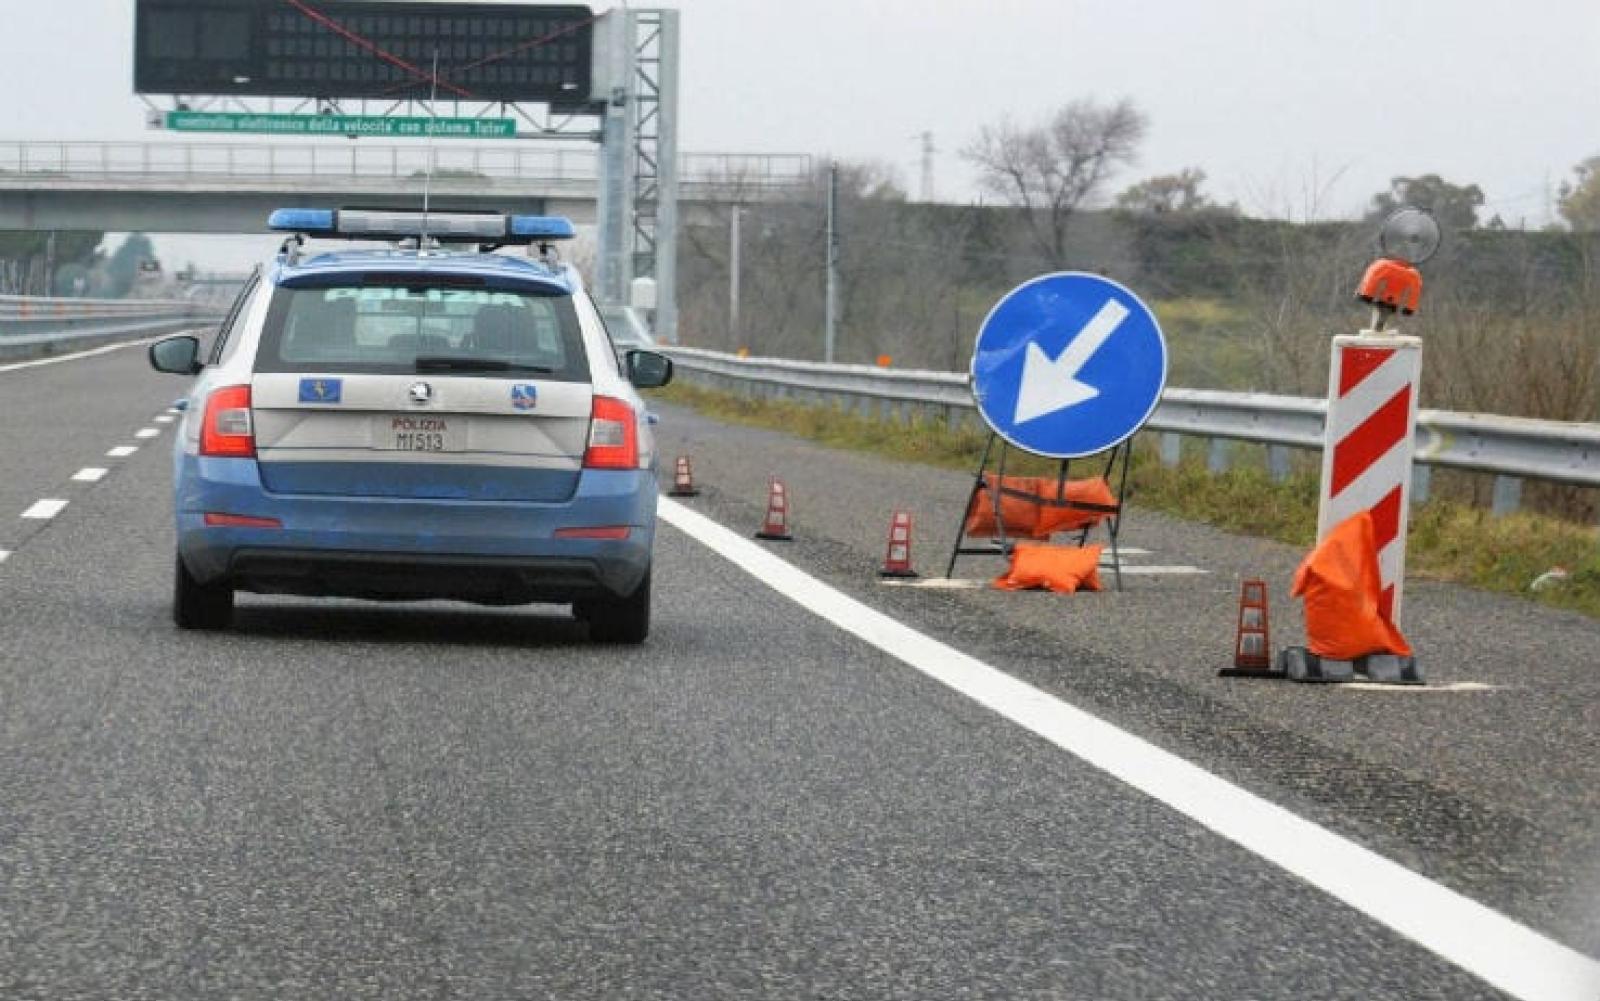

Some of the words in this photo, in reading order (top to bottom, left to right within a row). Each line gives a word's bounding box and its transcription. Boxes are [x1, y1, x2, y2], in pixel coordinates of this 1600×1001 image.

[309, 117, 339, 131] della
[399, 122, 422, 133] con
[425, 120, 471, 134] sistema
[391, 417, 447, 431] POLIZIA
